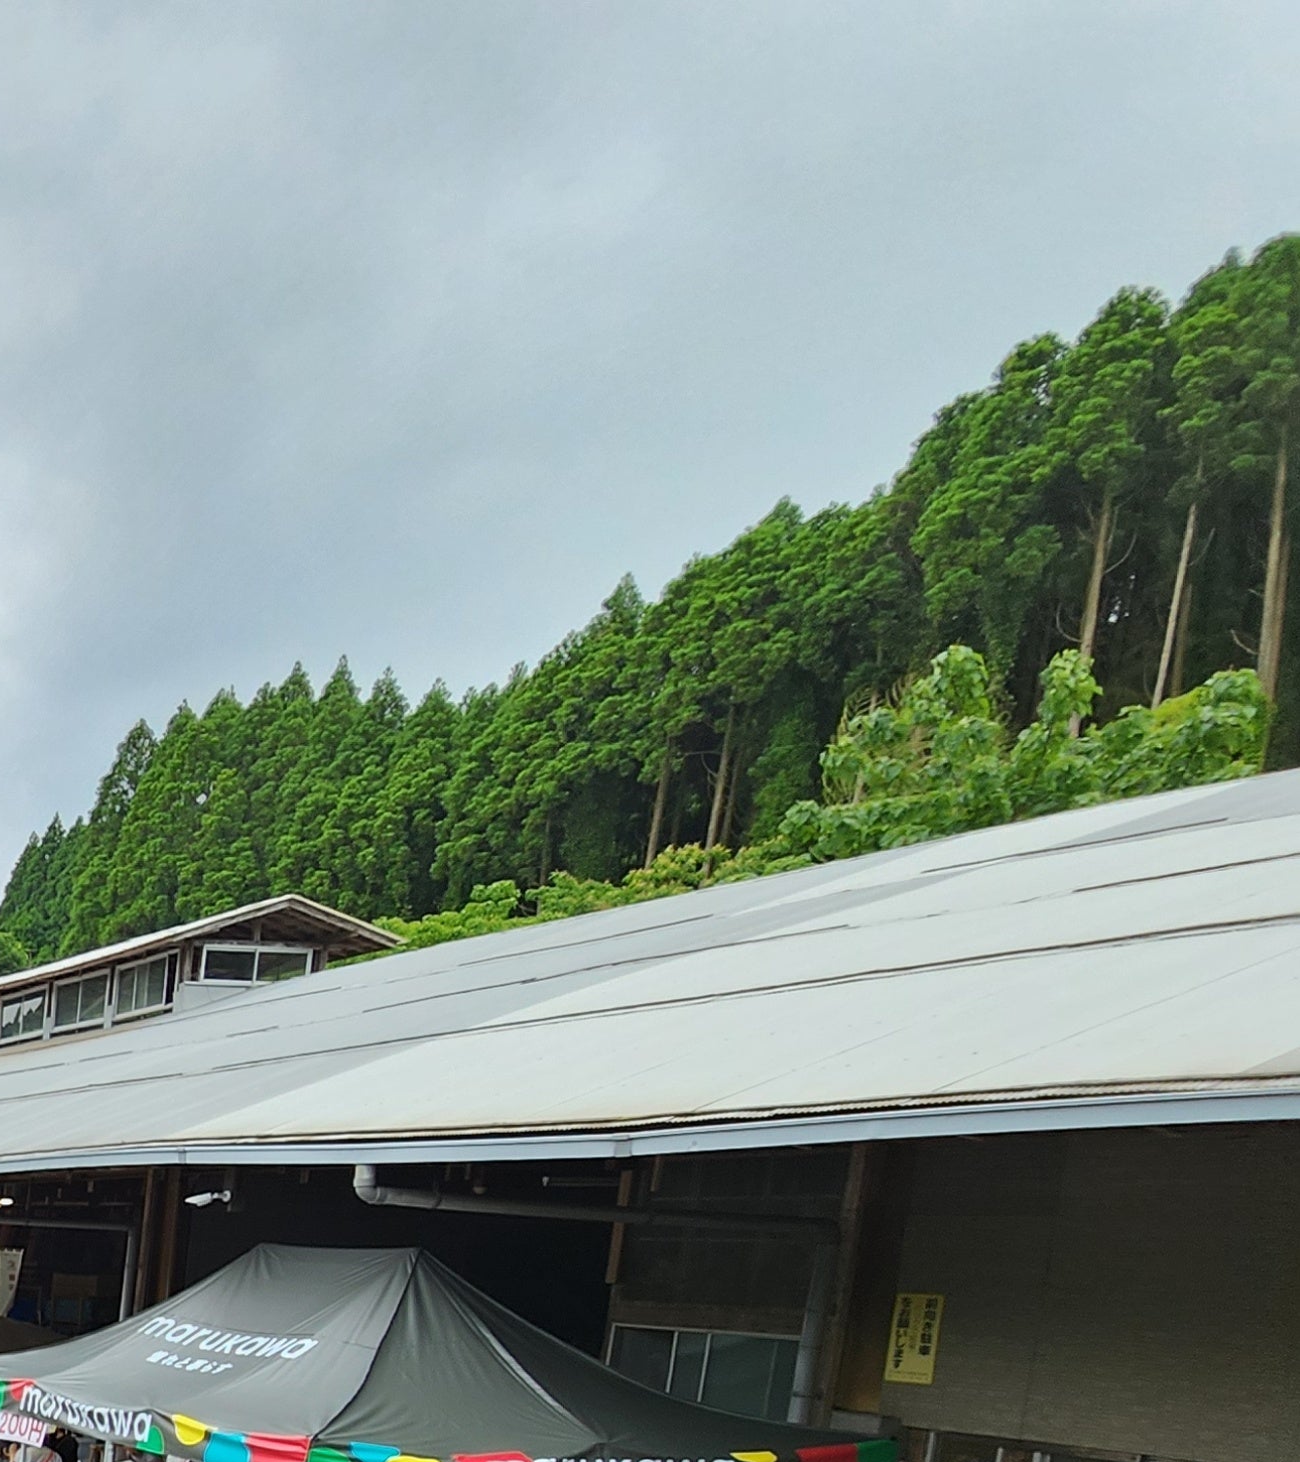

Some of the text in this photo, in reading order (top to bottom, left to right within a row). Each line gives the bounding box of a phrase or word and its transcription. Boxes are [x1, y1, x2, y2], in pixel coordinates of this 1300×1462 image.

[138, 1315, 319, 1360] marukawa
[0, 1411, 45, 1444] 200円
[19, 1384, 152, 1443] marukawa
